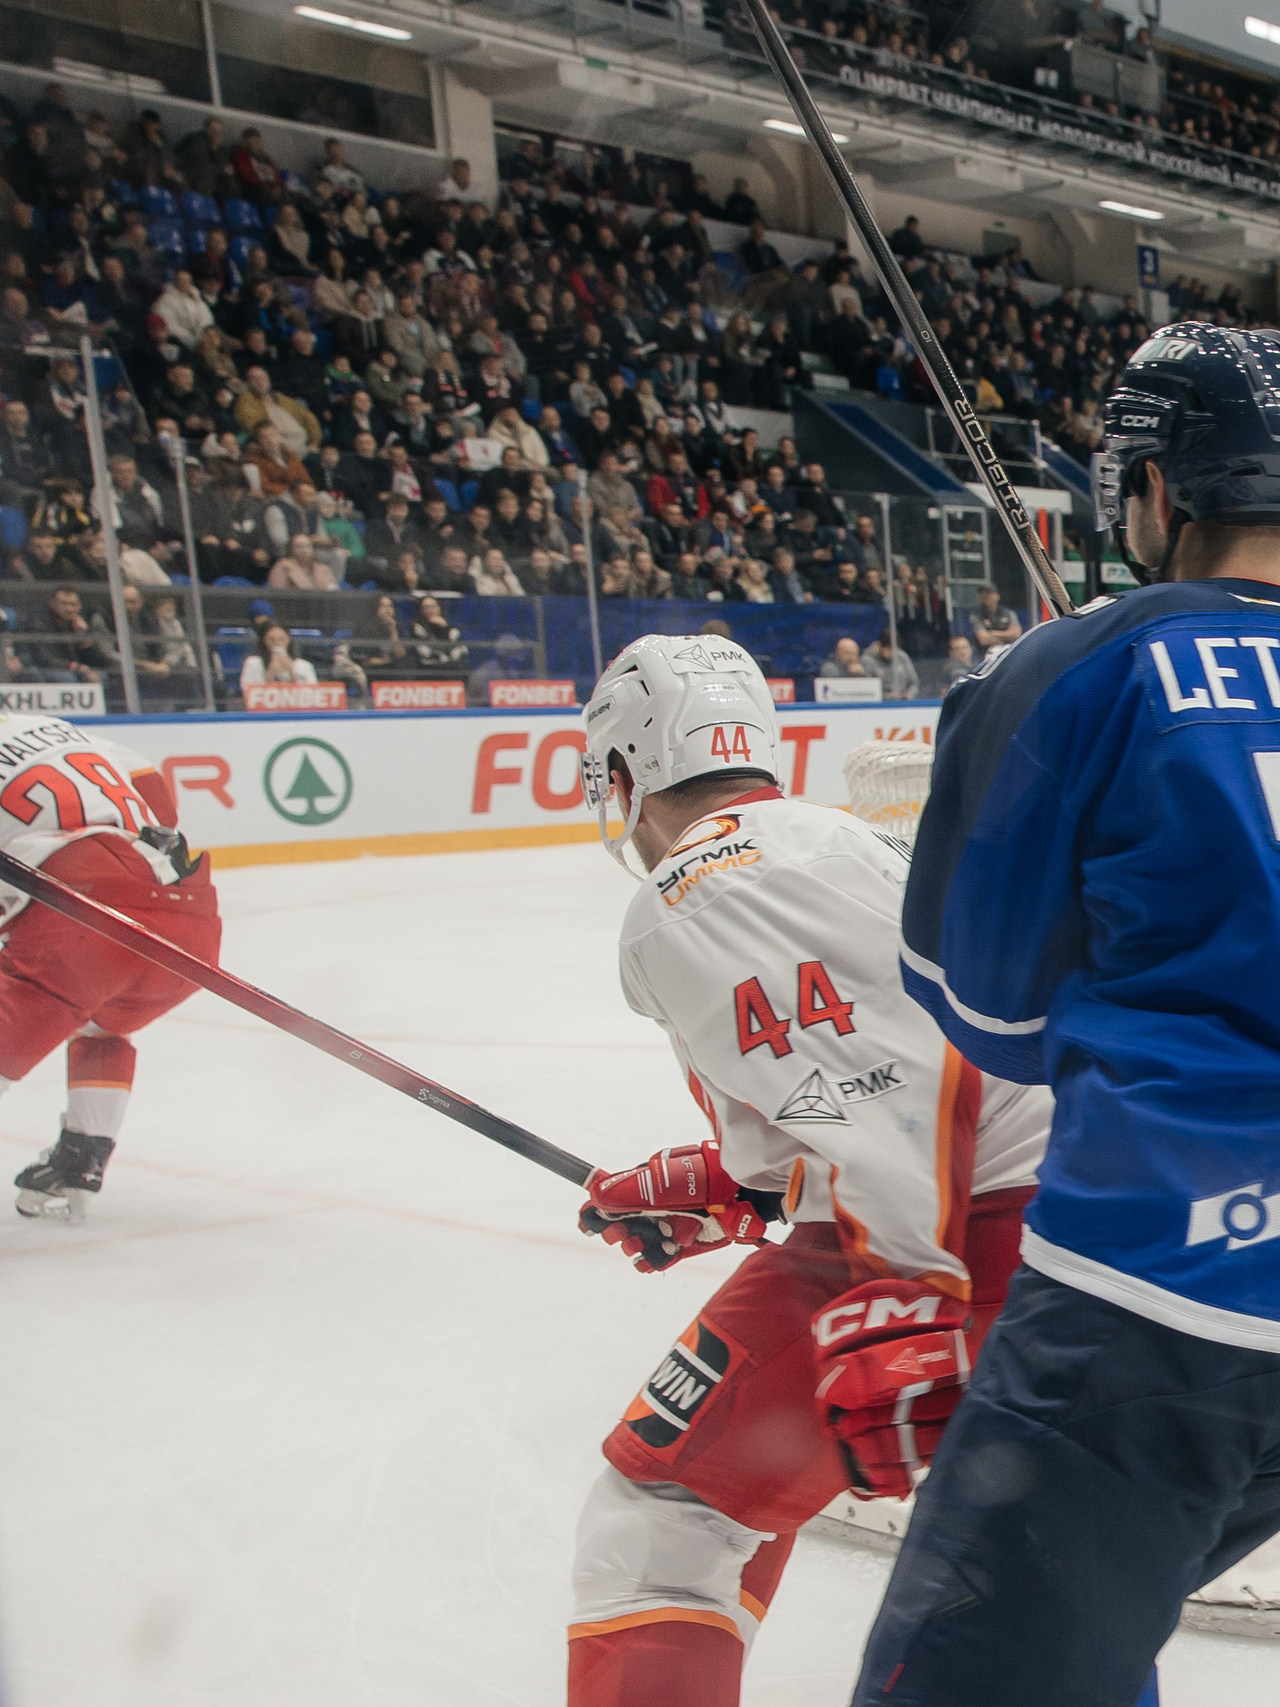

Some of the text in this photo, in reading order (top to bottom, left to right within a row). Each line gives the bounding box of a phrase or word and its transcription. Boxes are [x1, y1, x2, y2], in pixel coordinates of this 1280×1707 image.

[1120, 414, 1160, 428] CCM
[953, 397, 1030, 530] RIBCOR
[249, 686, 342, 709] FONBET
[375, 685, 463, 708] FONBET
[491, 684, 575, 706] FONBET
[711, 726, 751, 763] 44
[662, 849, 763, 907] UMMC
[733, 960, 857, 1060] 44
[811, 1296, 942, 1348] CM
